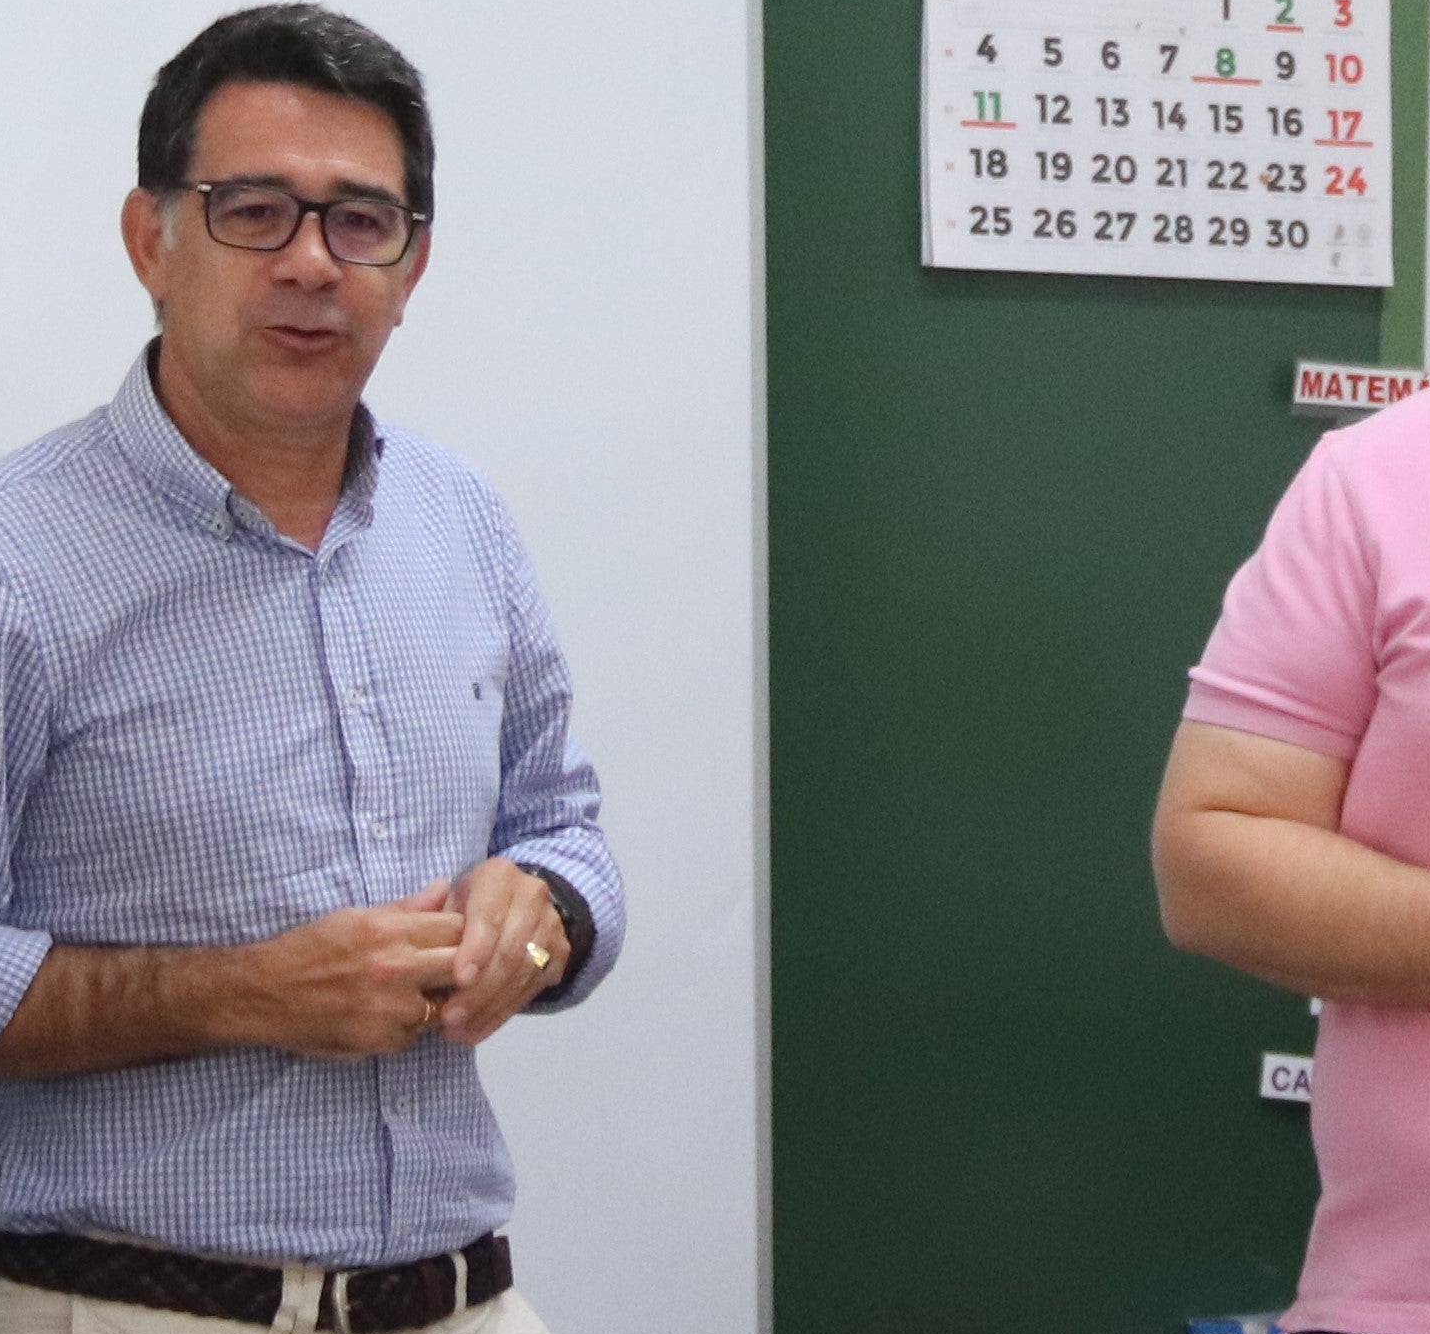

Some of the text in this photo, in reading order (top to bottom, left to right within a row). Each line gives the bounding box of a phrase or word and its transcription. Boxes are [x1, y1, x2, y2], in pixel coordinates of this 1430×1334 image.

[976, 33, 1364, 84] 4 5 6 7 8 9 10
[973, 91, 1361, 141] 11 12 13 14 15 16 17
[970, 149, 1367, 196] 18 19 20 21 22 23 24
[970, 206, 1012, 237] 25
[1033, 209, 1076, 239] 26
[1094, 212, 1136, 242] 27
[1153, 214, 1194, 245] 28
[1208, 217, 1250, 248] 29
[1266, 220, 1309, 250] 30
